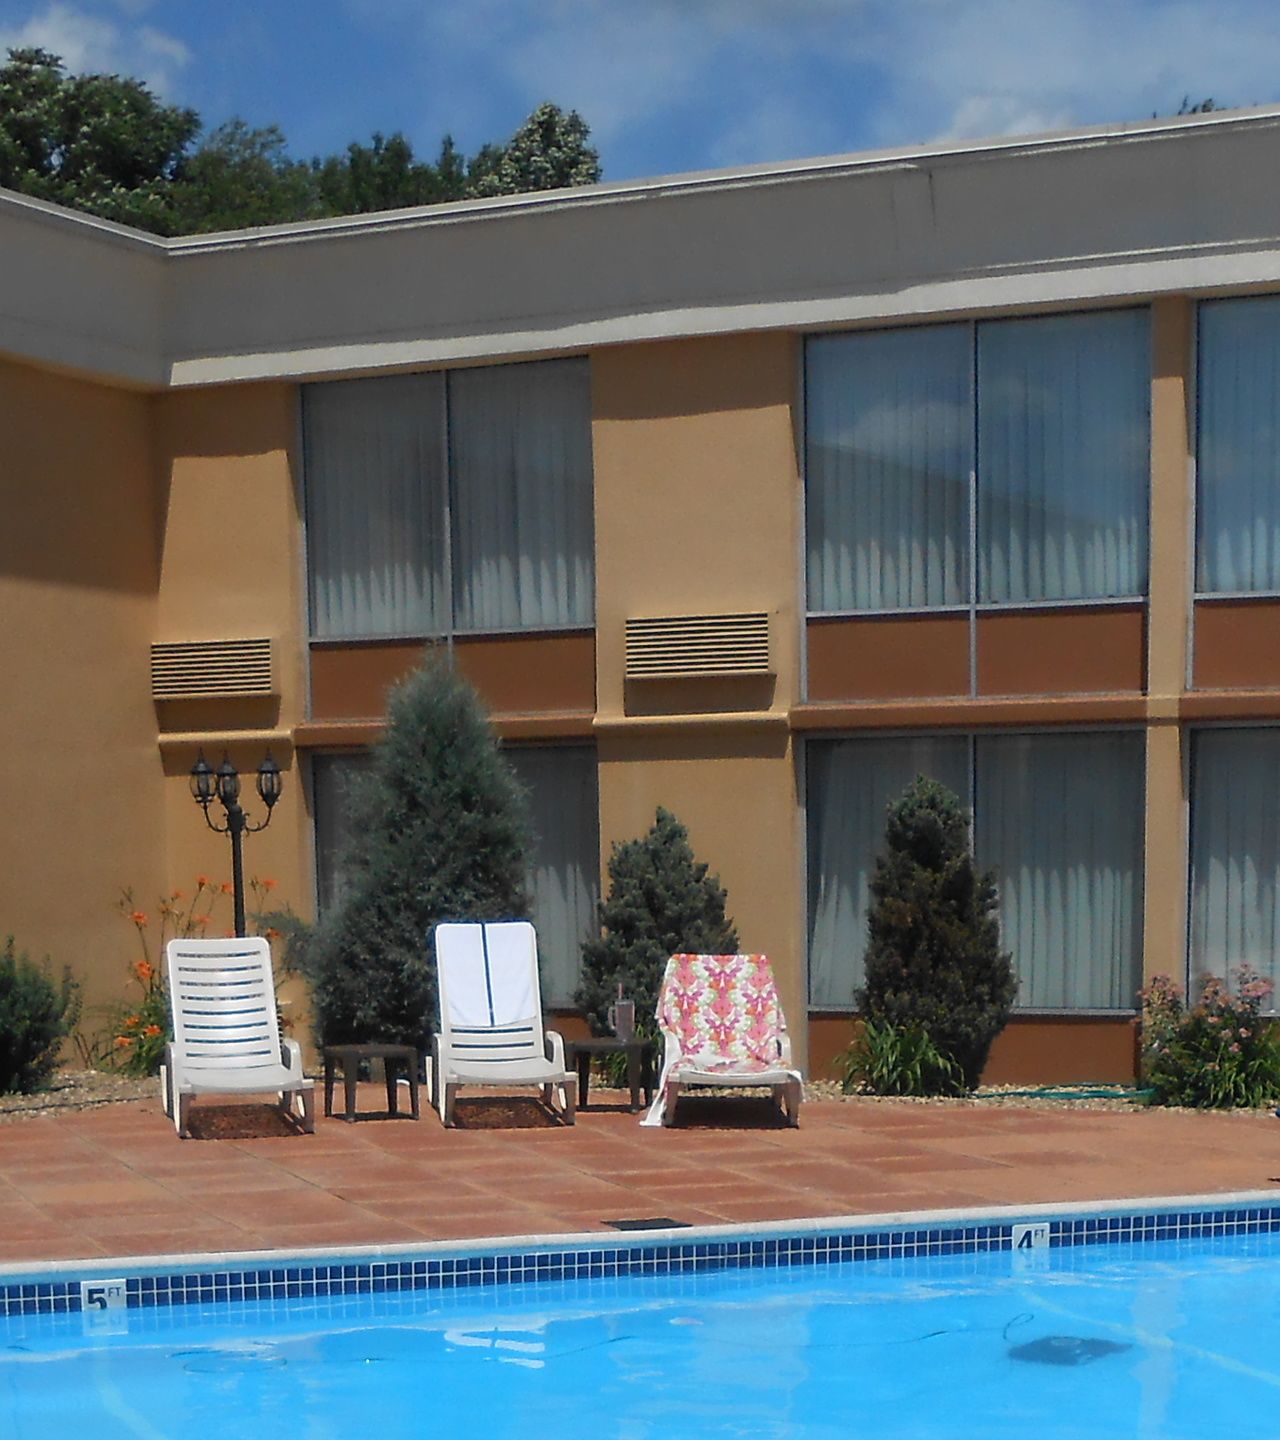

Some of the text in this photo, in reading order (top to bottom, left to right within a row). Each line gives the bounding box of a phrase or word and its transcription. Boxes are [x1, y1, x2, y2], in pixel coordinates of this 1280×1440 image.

[1034, 1229, 1045, 1239] FT
[87, 1286, 121, 1310] 5 FT
